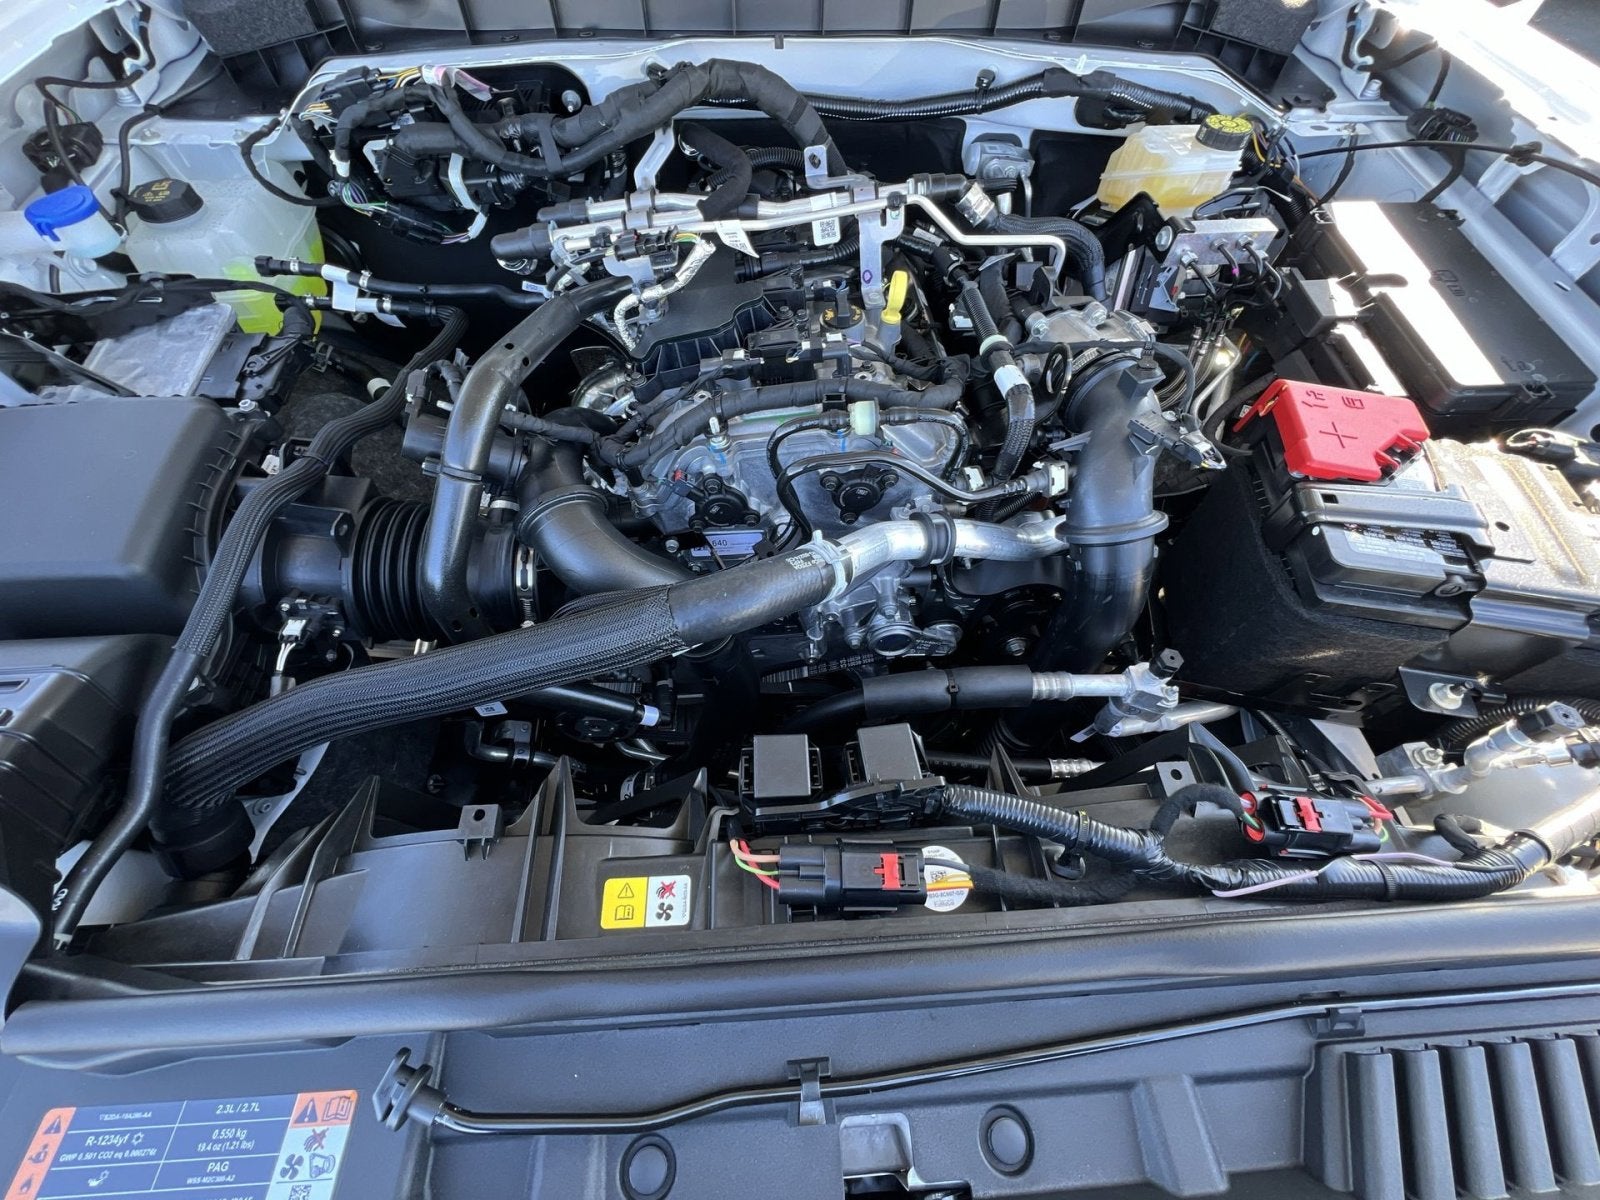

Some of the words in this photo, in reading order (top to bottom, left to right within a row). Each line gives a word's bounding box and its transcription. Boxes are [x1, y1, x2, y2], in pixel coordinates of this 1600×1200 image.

[215, 1103, 234, 1114] 2.3L
[235, 1102, 243, 1113] /
[241, 1101, 260, 1112] 2.7L
[85, 1132, 130, 1147] R-1234yf
[212, 1127, 236, 1140] 0.550
[236, 1127, 248, 1140] kg
[197, 1141, 213, 1152] 19.4
[212, 1143, 222, 1151] oz
[221, 1140, 239, 1152] (1.21
[206, 1161, 230, 1173] PAG
